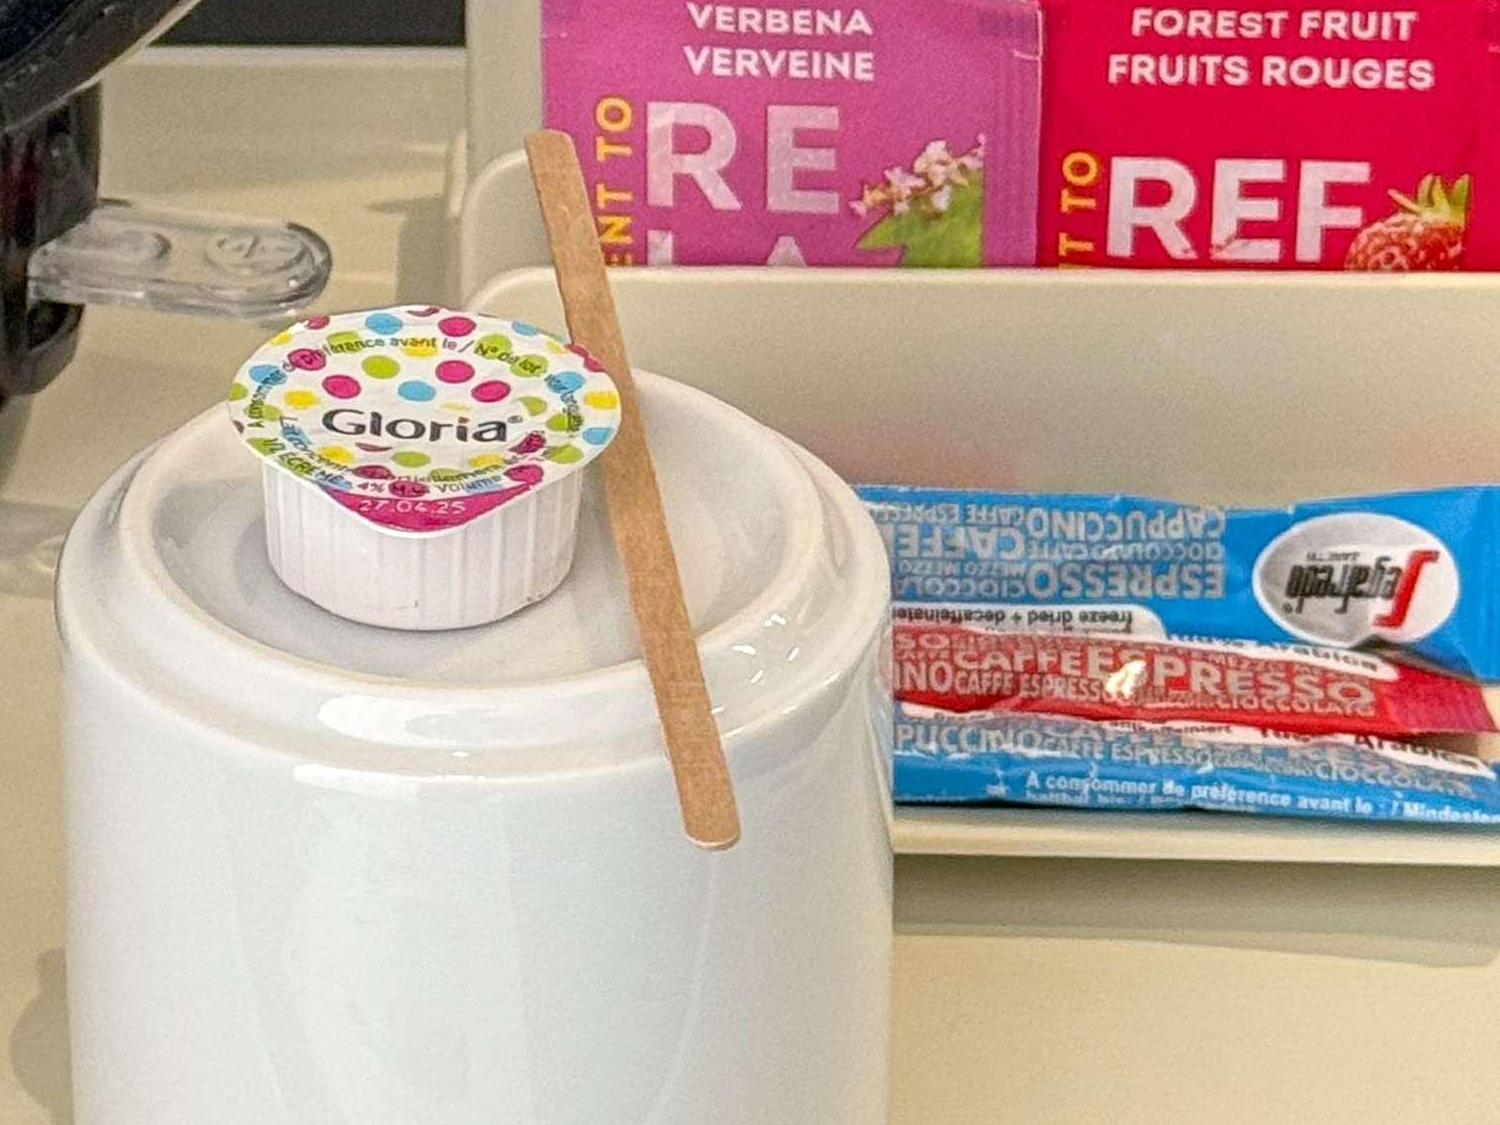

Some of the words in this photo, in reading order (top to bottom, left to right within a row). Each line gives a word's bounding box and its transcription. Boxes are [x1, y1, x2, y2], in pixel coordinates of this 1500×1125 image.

[686, 2, 875, 35] VERBENA
[1131, 7, 1290, 40] FOREST
[1299, 10, 1418, 41] FRUIT
[684, 45, 875, 82] VERVEINE
[1107, 53, 1250, 86] FRUITS
[1262, 56, 1436, 90] ROUGES
[595, 96, 633, 163] TO
[1060, 151, 1099, 215] TO
[1105, 156, 1372, 263] REF
[389, 337, 437, 349] avant
[359, 498, 467, 516] 27.04.25
[1025, 506, 1226, 543] CAPPUCCINO
[1025, 562, 1226, 600] ESPRESSO
[1282, 550, 1441, 631] Segafredo
[1027, 609, 1073, 627] dried
[1078, 608, 1133, 627] freeze
[953, 647, 1082, 676] CAFFE
[954, 670, 1013, 695] CAFFE
[1298, 792, 1350, 813] avant
